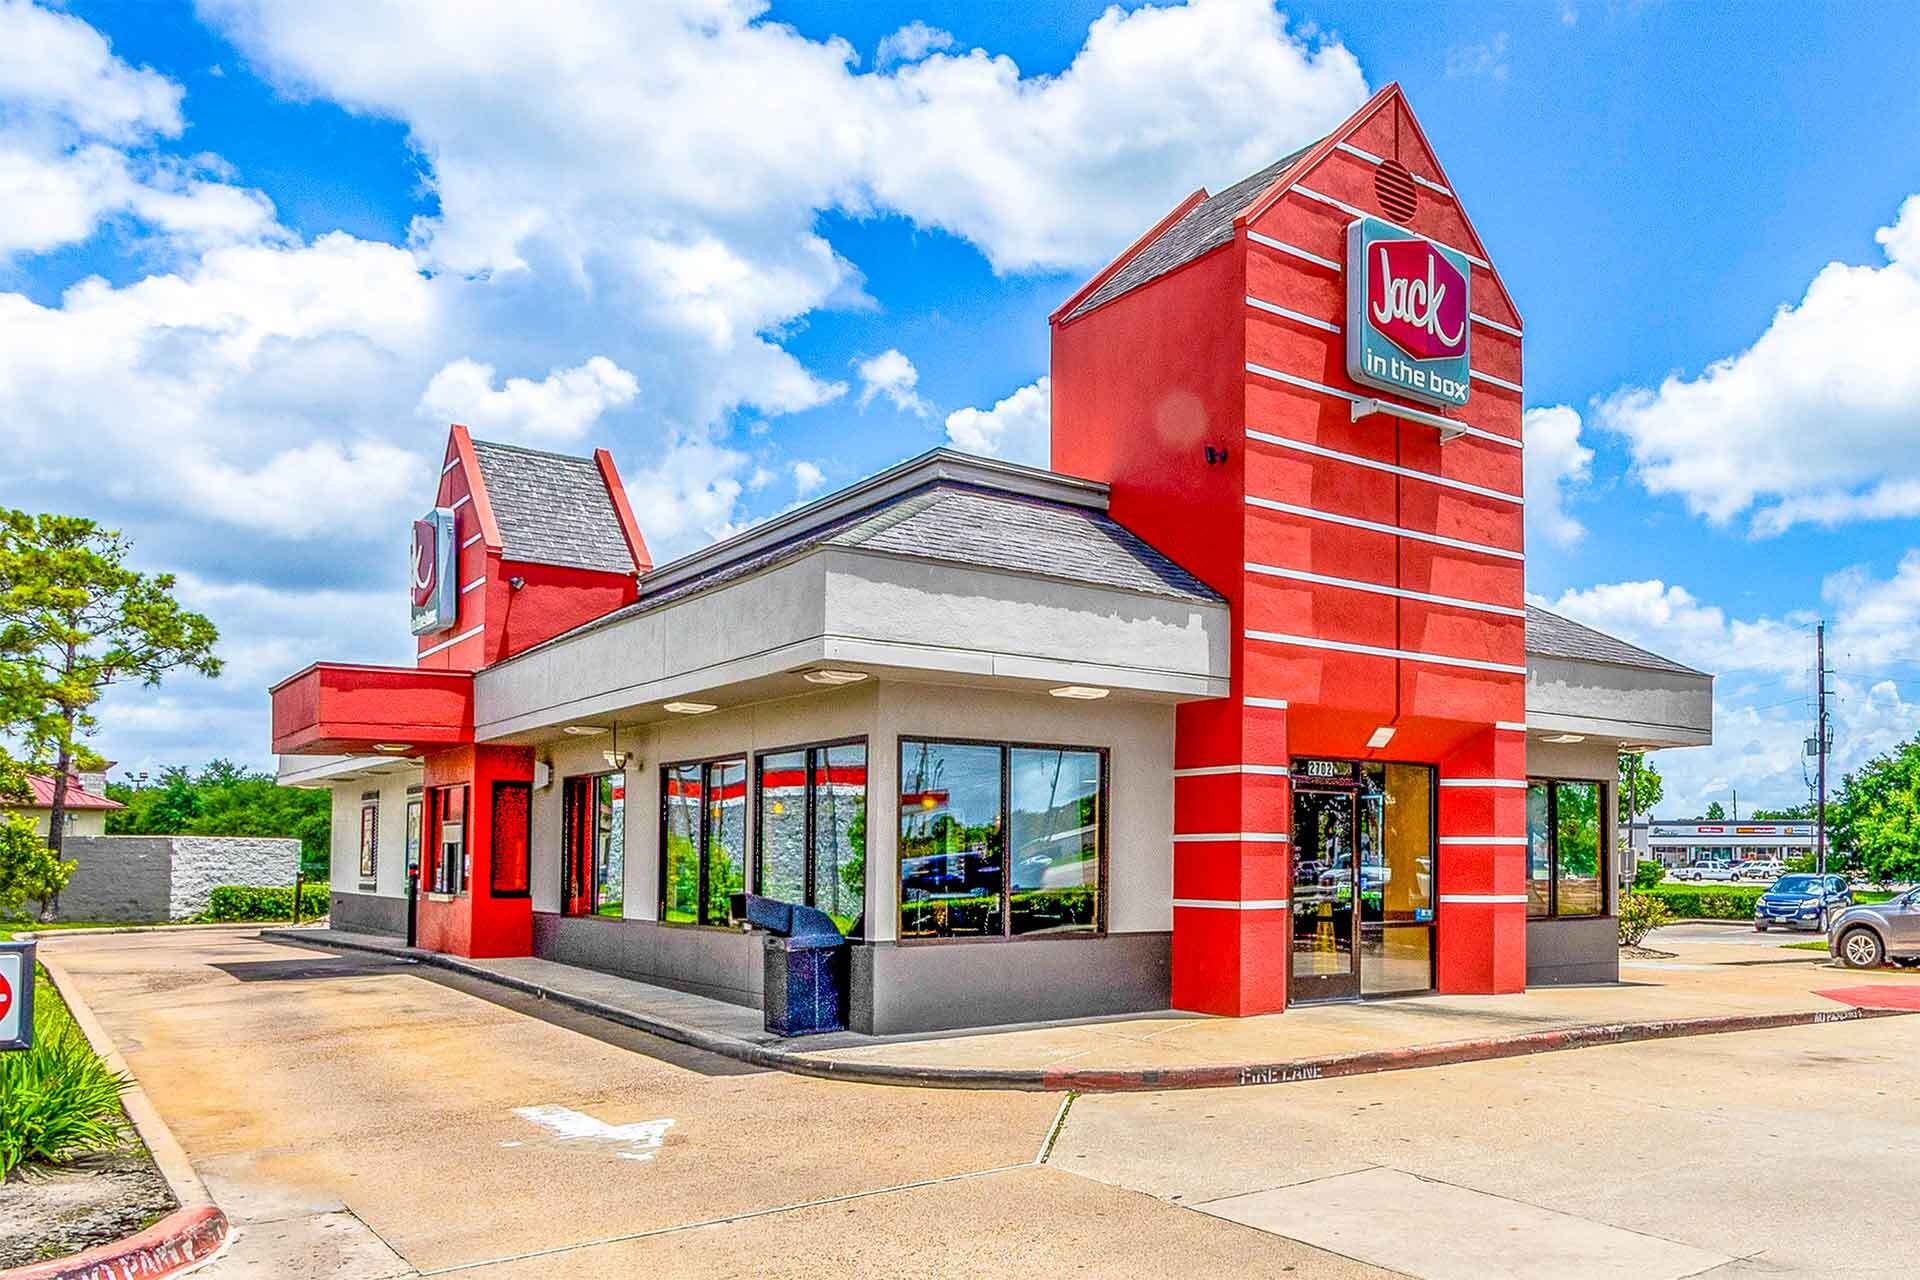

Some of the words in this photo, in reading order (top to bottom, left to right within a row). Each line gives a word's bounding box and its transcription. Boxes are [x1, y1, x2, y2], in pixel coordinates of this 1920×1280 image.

[1373, 247, 1464, 347] Jack
[1367, 348, 1386, 375] in
[1391, 357, 1425, 388] the
[1430, 370, 1468, 400] box
[1308, 761, 1333, 776] 2702
[1240, 1067, 1278, 1085] FIRE
[1282, 1063, 1322, 1081] LANE
